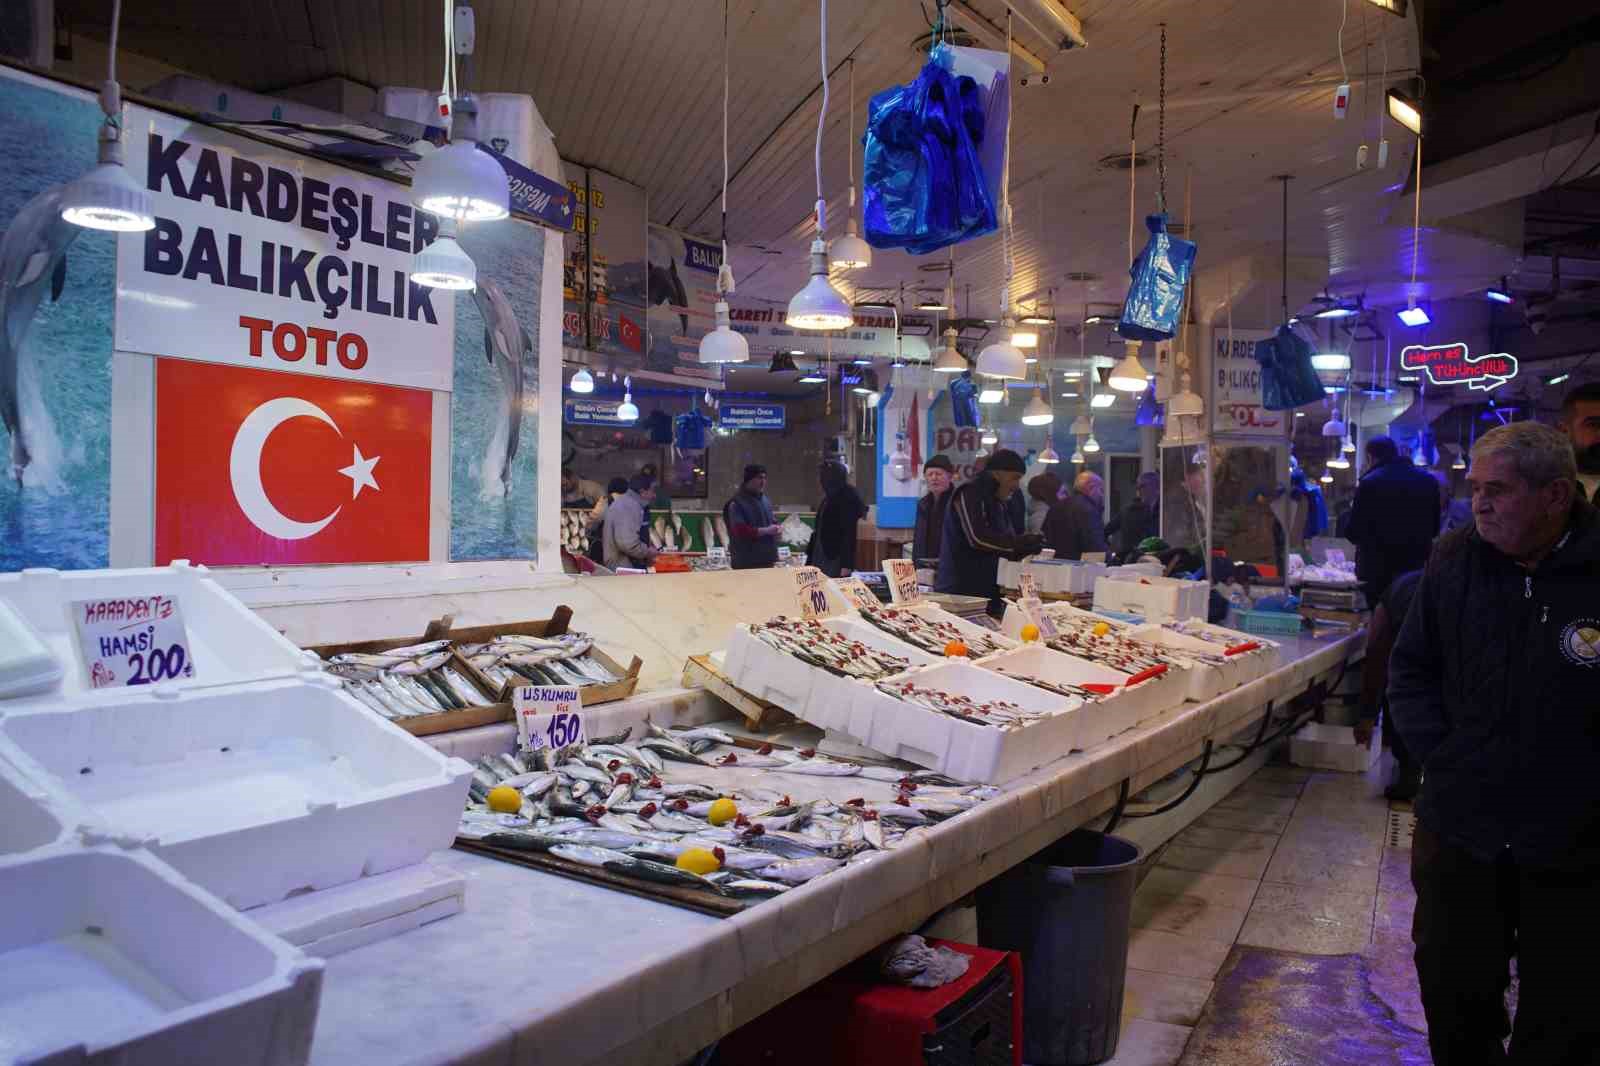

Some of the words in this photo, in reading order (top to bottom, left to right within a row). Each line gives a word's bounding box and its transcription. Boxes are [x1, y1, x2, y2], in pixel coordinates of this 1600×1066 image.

[147, 133, 439, 255] KARDEŞLER
[144, 216, 438, 325] BALIKÇILIK
[239, 315, 369, 371] TOTO
[523, 688, 577, 702] USKUMRU
